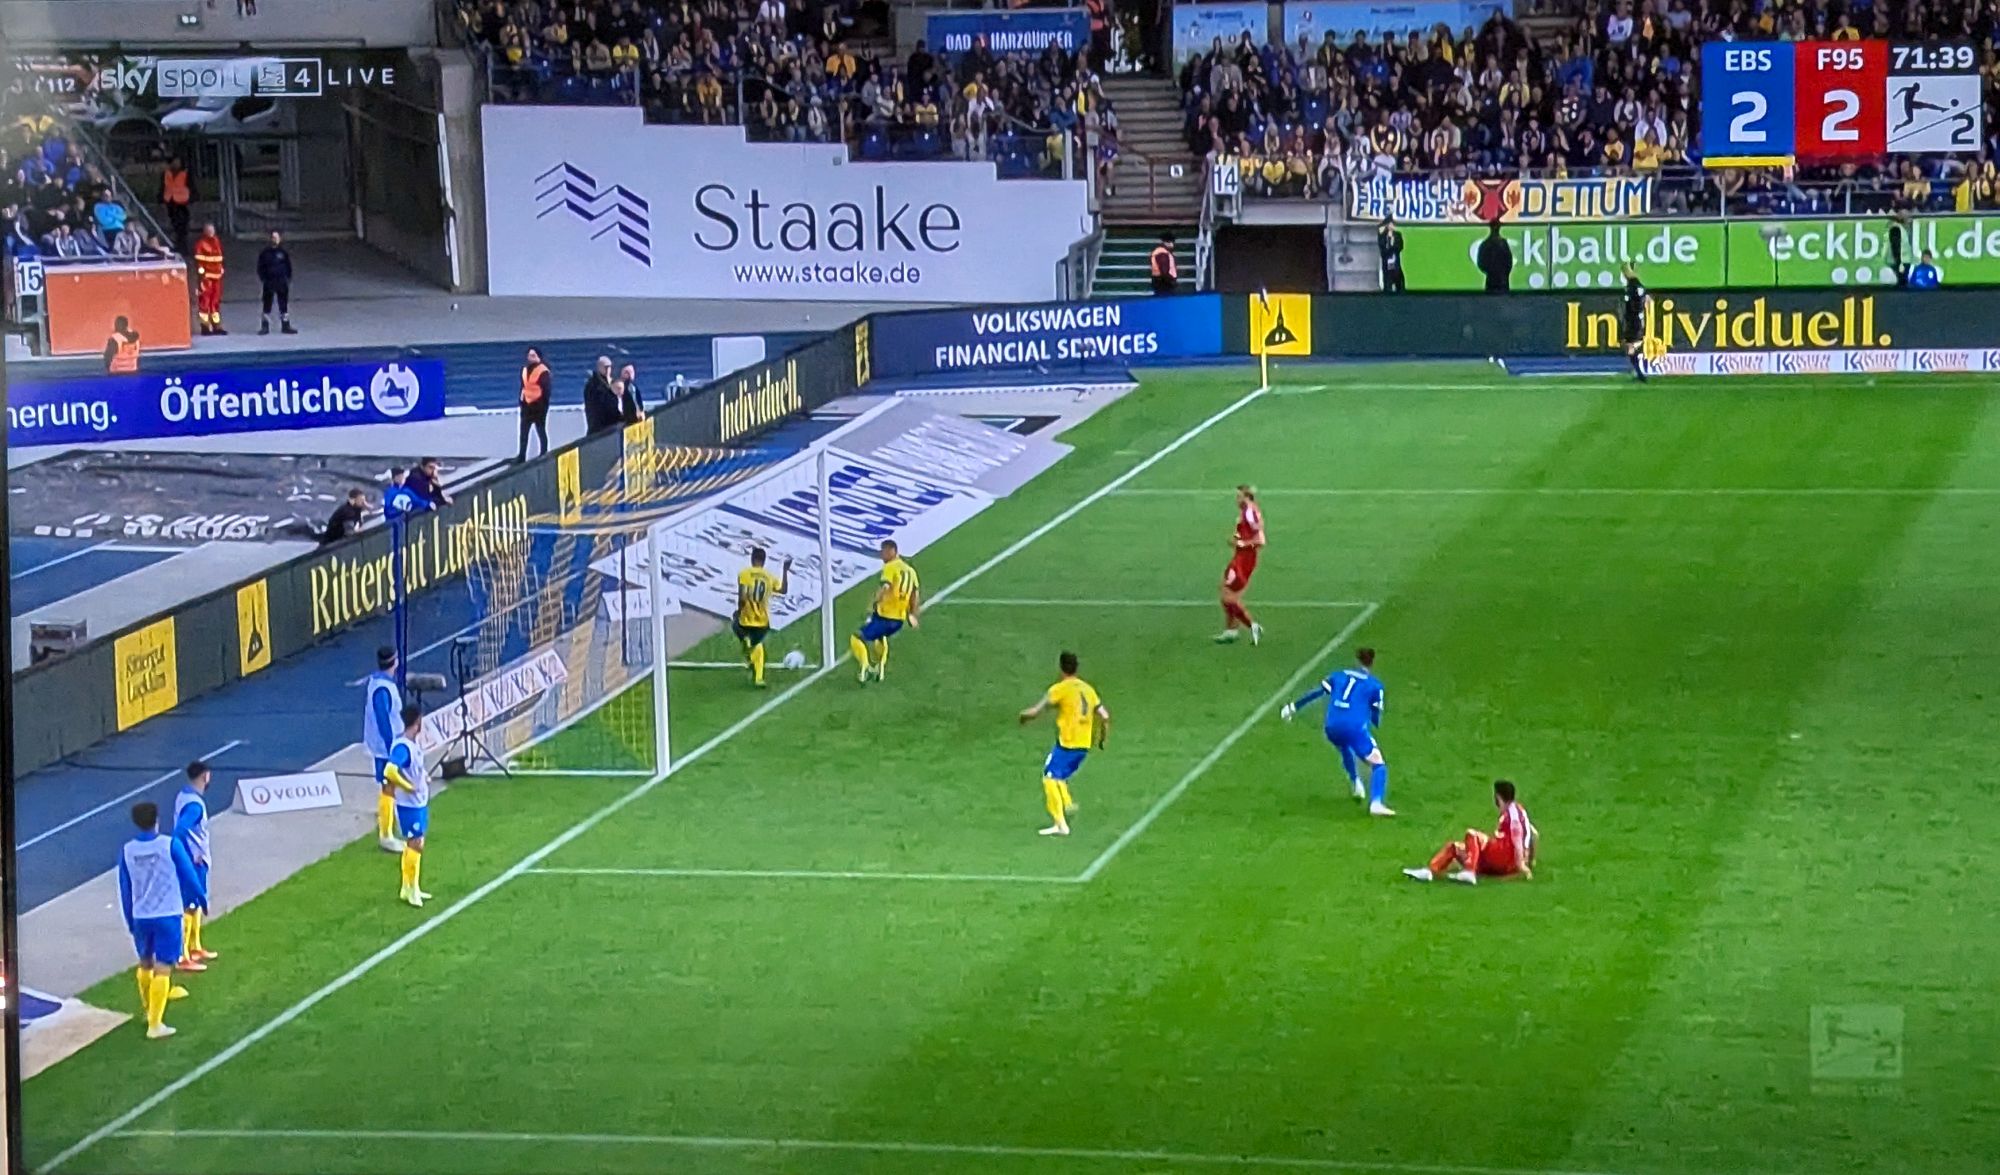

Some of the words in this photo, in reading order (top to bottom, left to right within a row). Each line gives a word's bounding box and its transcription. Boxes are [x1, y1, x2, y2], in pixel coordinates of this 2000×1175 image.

[1724, 48, 1773, 72] EBS
[1817, 47, 1865, 71] F95
[1892, 46, 1975, 71] 71:39
[101, 61, 153, 96] sky
[294, 67, 312, 88] 4
[328, 67, 395, 86] LIVE
[1728, 90, 1768, 143] 2
[1821, 88, 1861, 142] 2
[1950, 112, 1975, 145] 2
[1212, 165, 1239, 192] 14
[693, 183, 961, 253] Staake
[1469, 224, 1699, 267] kball.de
[17, 263, 44, 293] 15
[733, 260, 921, 284] www.staake.de
[972, 304, 1121, 336] VOLKSWAGEN
[935, 339, 1052, 369] FINANCIAL
[159, 376, 365, 422] Öffentliche
[718, 357, 803, 444] Individuell.
[1341, 676, 1358, 701] 1
[273, 783, 333, 801] VEOLIA
